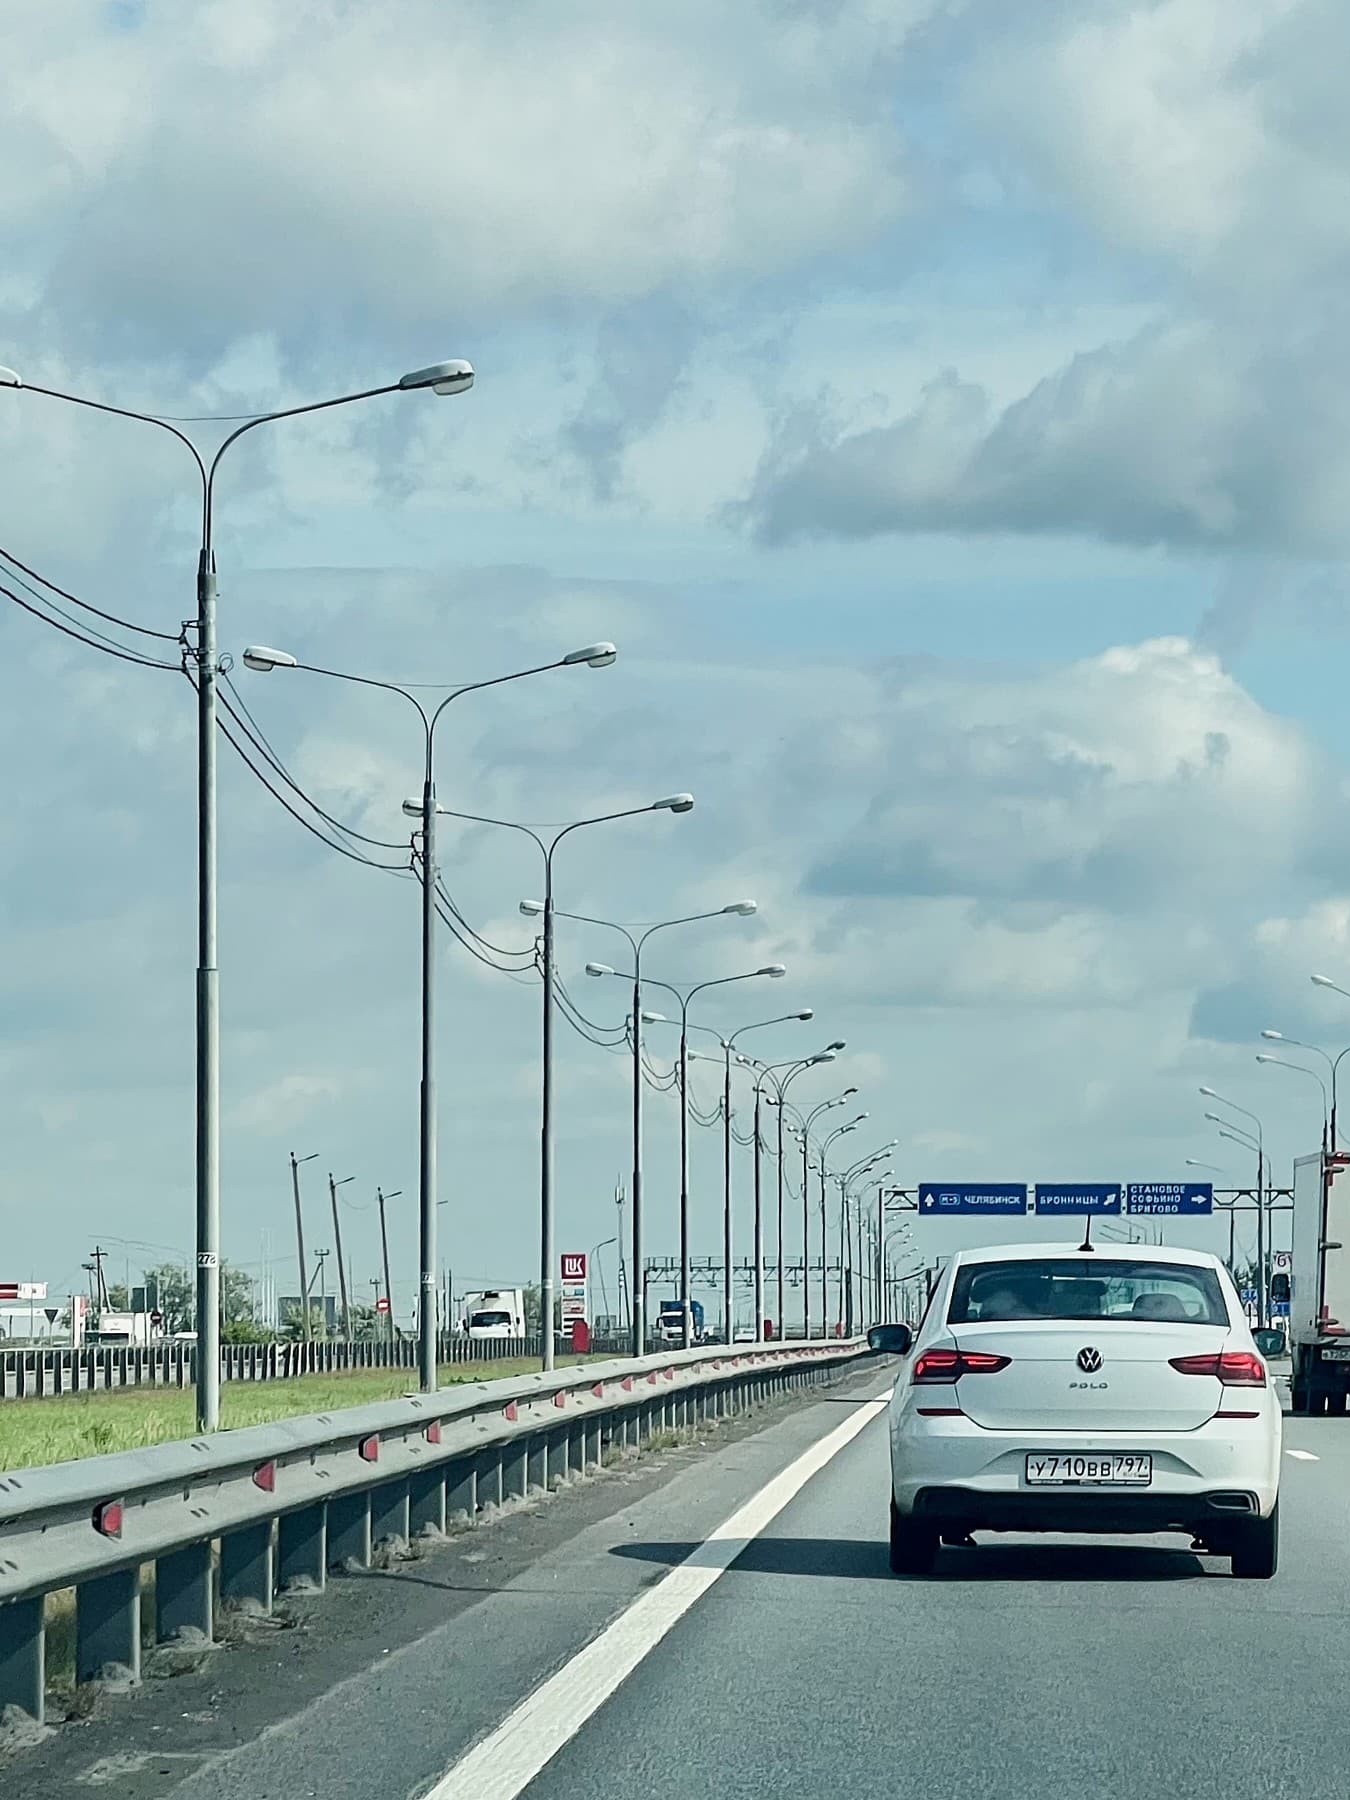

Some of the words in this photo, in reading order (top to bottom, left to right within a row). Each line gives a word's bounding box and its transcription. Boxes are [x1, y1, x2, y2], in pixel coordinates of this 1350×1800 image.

[1130, 1185, 1186, 1194] СТАНОВОЕ
[964, 1195, 1021, 1205] ЧЕЛЯБИНСК
[1039, 1195, 1099, 1205] БРОННИЦЫ
[1130, 1194, 1181, 1203] СОФЬИНО
[1130, 1204, 1179, 1213] БРИТОВО
[1115, 1456, 1145, 1473] 797
